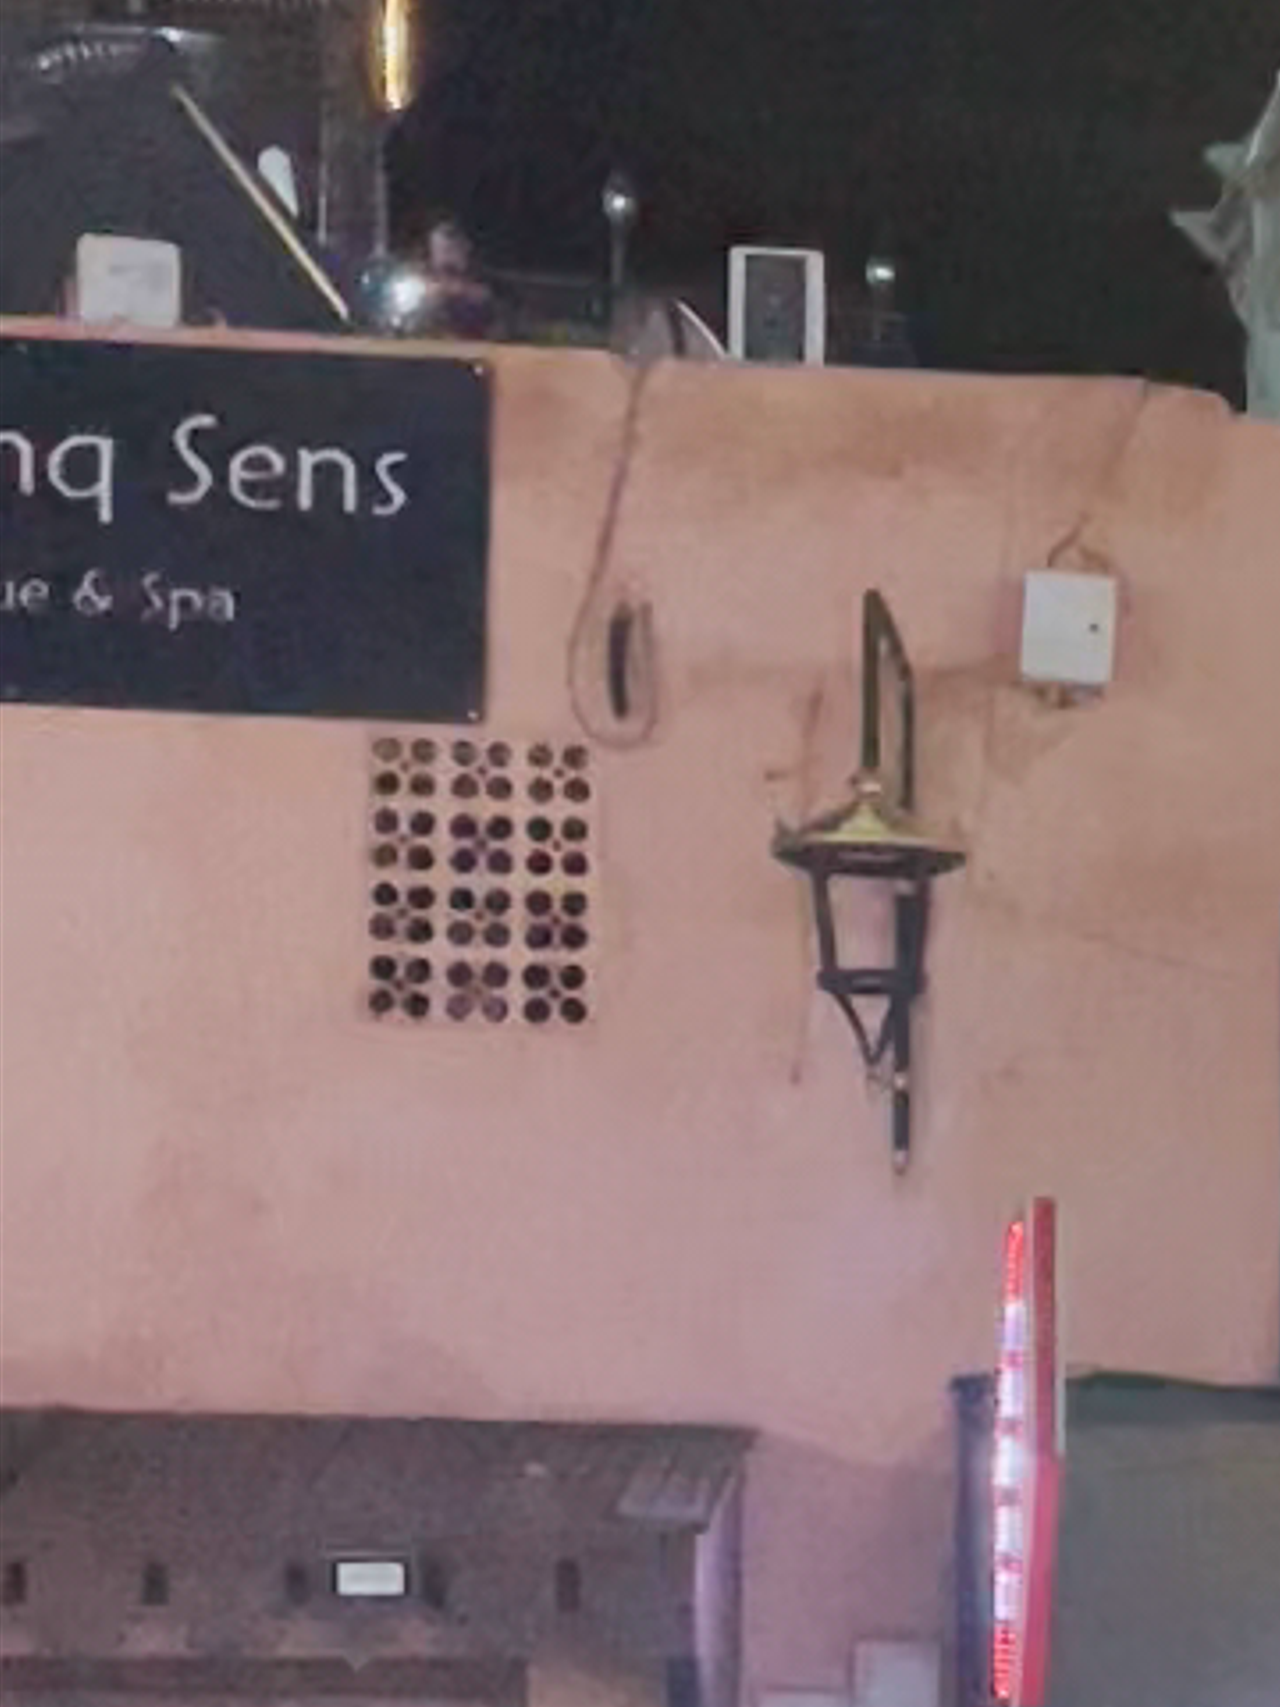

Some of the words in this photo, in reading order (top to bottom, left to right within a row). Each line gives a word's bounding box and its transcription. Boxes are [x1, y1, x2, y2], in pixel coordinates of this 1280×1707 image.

[166, 412, 408, 516] Sens
[72, 568, 113, 617] &
[140, 570, 236, 632] Spa
